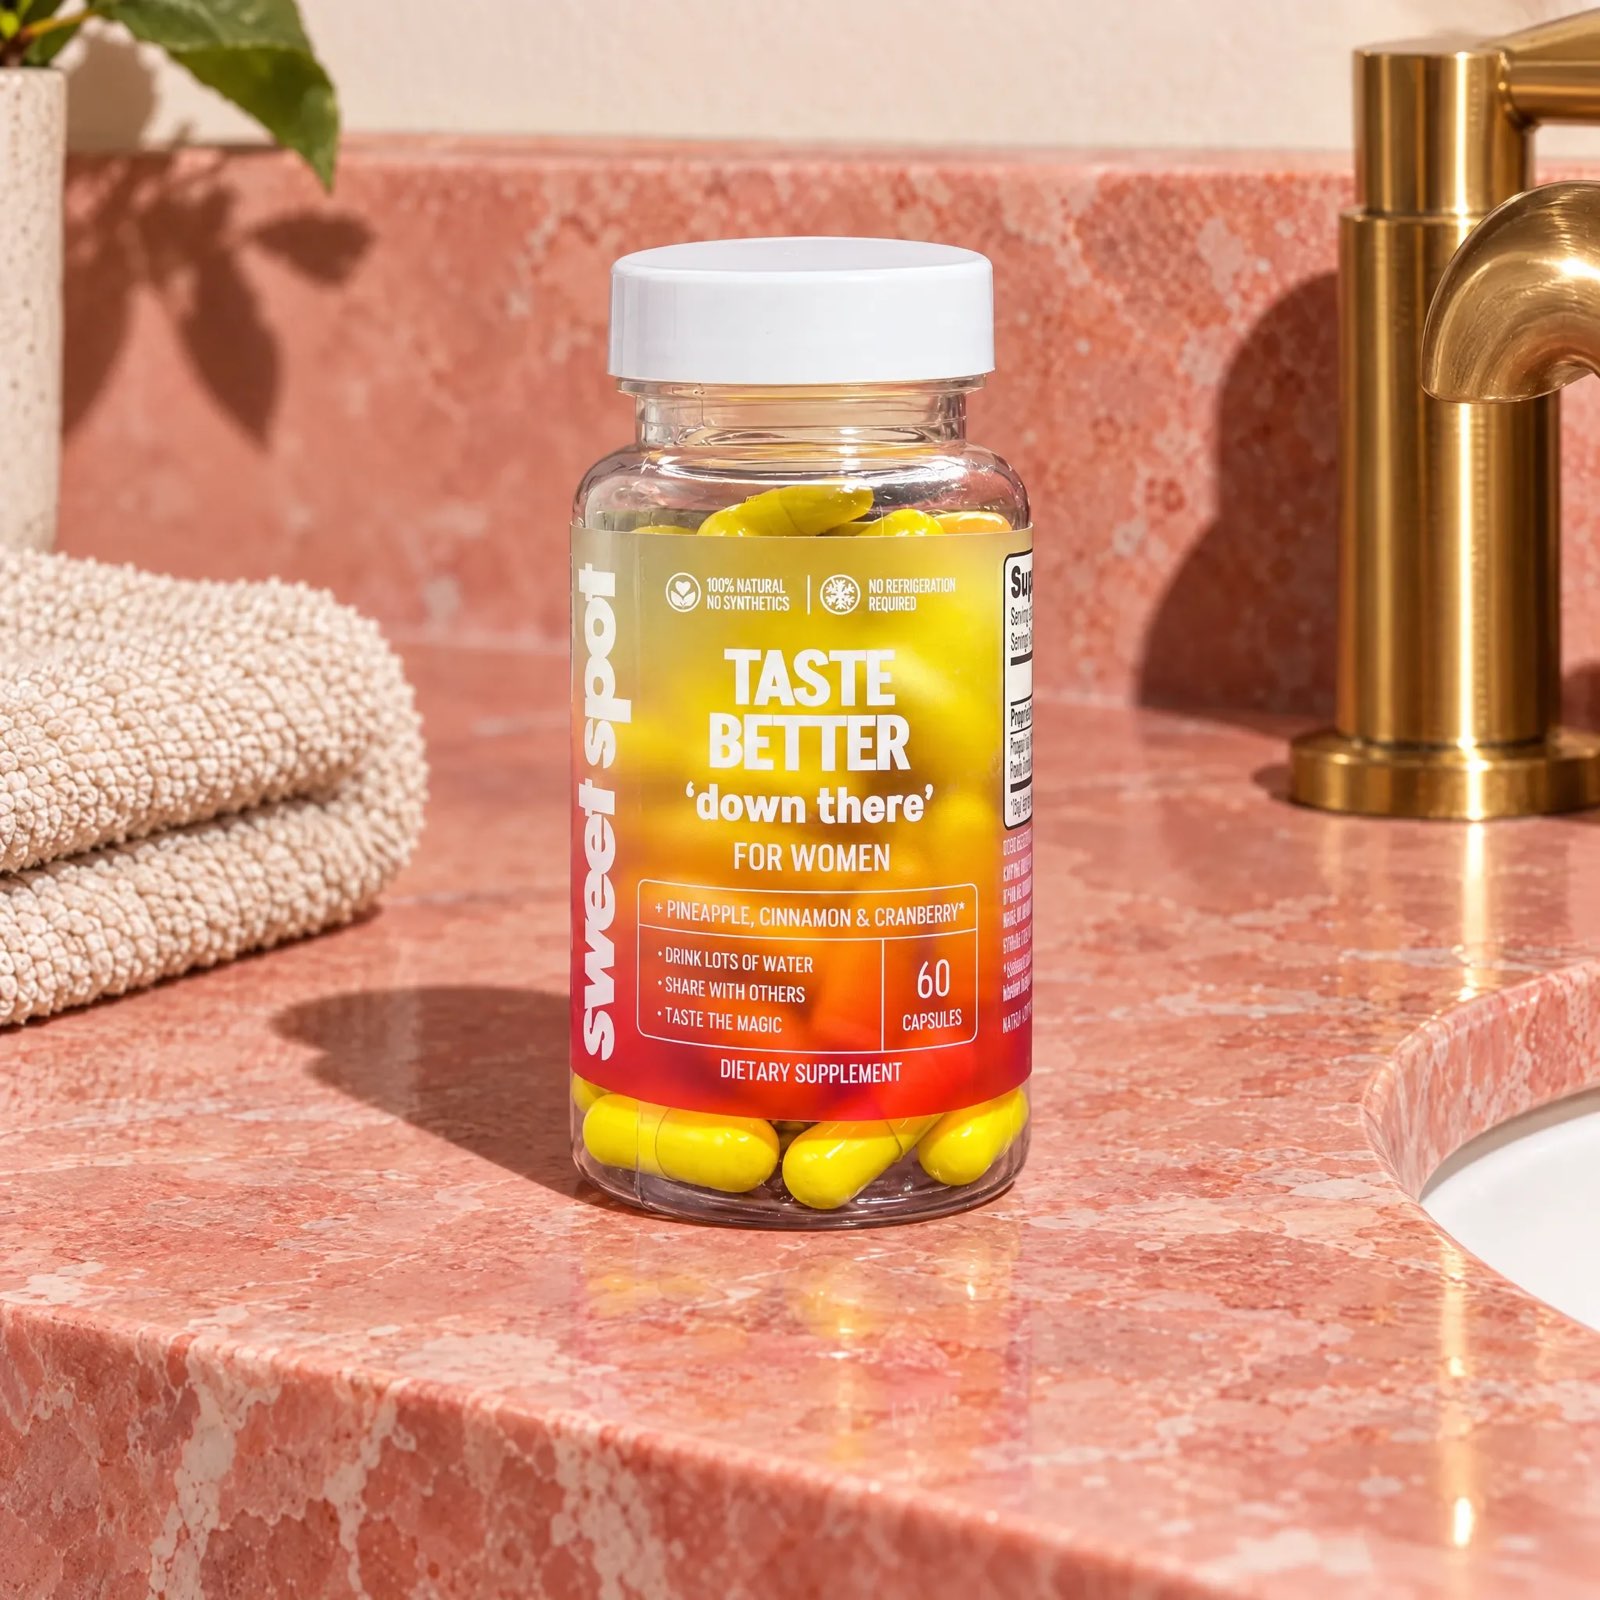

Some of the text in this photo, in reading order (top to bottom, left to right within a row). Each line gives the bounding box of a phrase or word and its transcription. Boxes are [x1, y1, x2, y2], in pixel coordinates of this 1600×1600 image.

[706, 577, 786, 594] 100% NATURAL
[868, 577, 956, 594] NO REFRIGERATION
[706, 595, 790, 612] NO SYNTHETICS
[868, 596, 917, 612] REQUIRED
[724, 648, 896, 706] TASTE
[709, 712, 911, 771] BETTER
[578, 562, 632, 1061] sweet spot
[733, 842, 891, 872] FOR WOMEN
[667, 900, 755, 928] PINEAPPLE,
[759, 907, 852, 928] CINNAMON
[856, 910, 870, 927] &
[665, 946, 814, 973] DRINK LOTS OF WATER
[665, 976, 806, 1003] SHARE WITH OTHERS
[916, 958, 950, 999] 60
[665, 1006, 783, 1034] TASTE THE MAGIC
[902, 1009, 963, 1032] CAPSULES
[720, 1058, 903, 1084] DIETARY SUPPLEMENT
